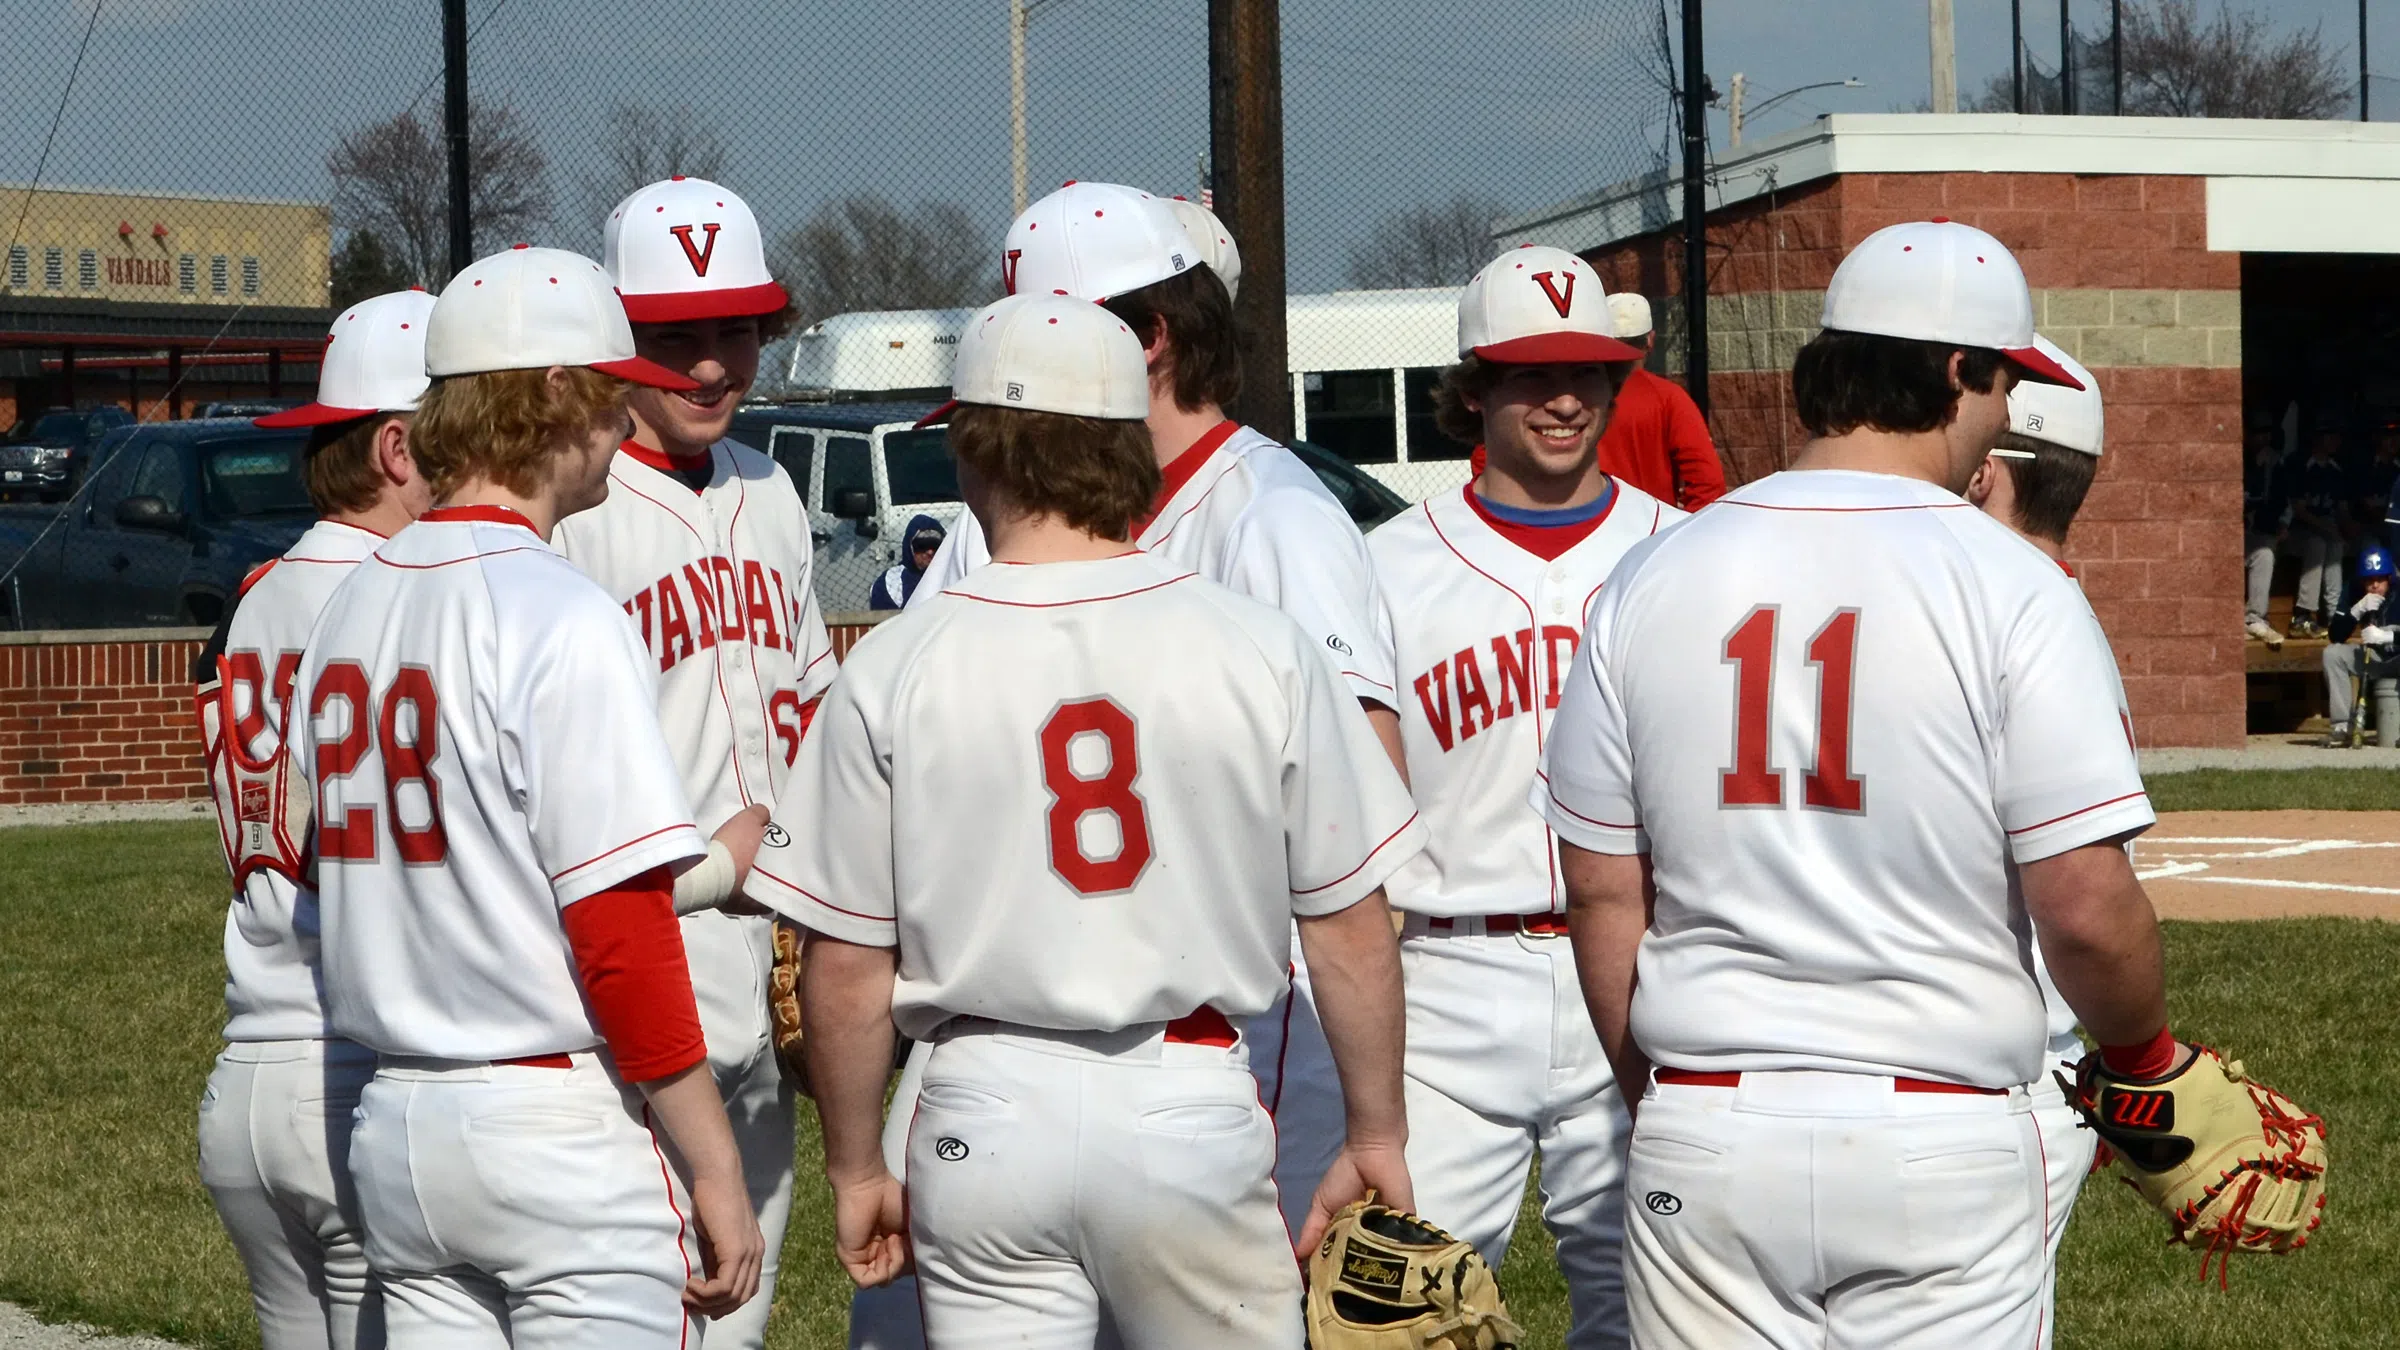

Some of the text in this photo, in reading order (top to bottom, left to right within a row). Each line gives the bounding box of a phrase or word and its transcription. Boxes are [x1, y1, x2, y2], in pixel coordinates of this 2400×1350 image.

[106, 255, 172, 287] VANDALS
[669, 223, 722, 277] V
[1531, 271, 1576, 319] V
[308, 658, 449, 868] 28
[1718, 602, 1867, 817] 11
[1035, 692, 1157, 900] 8
